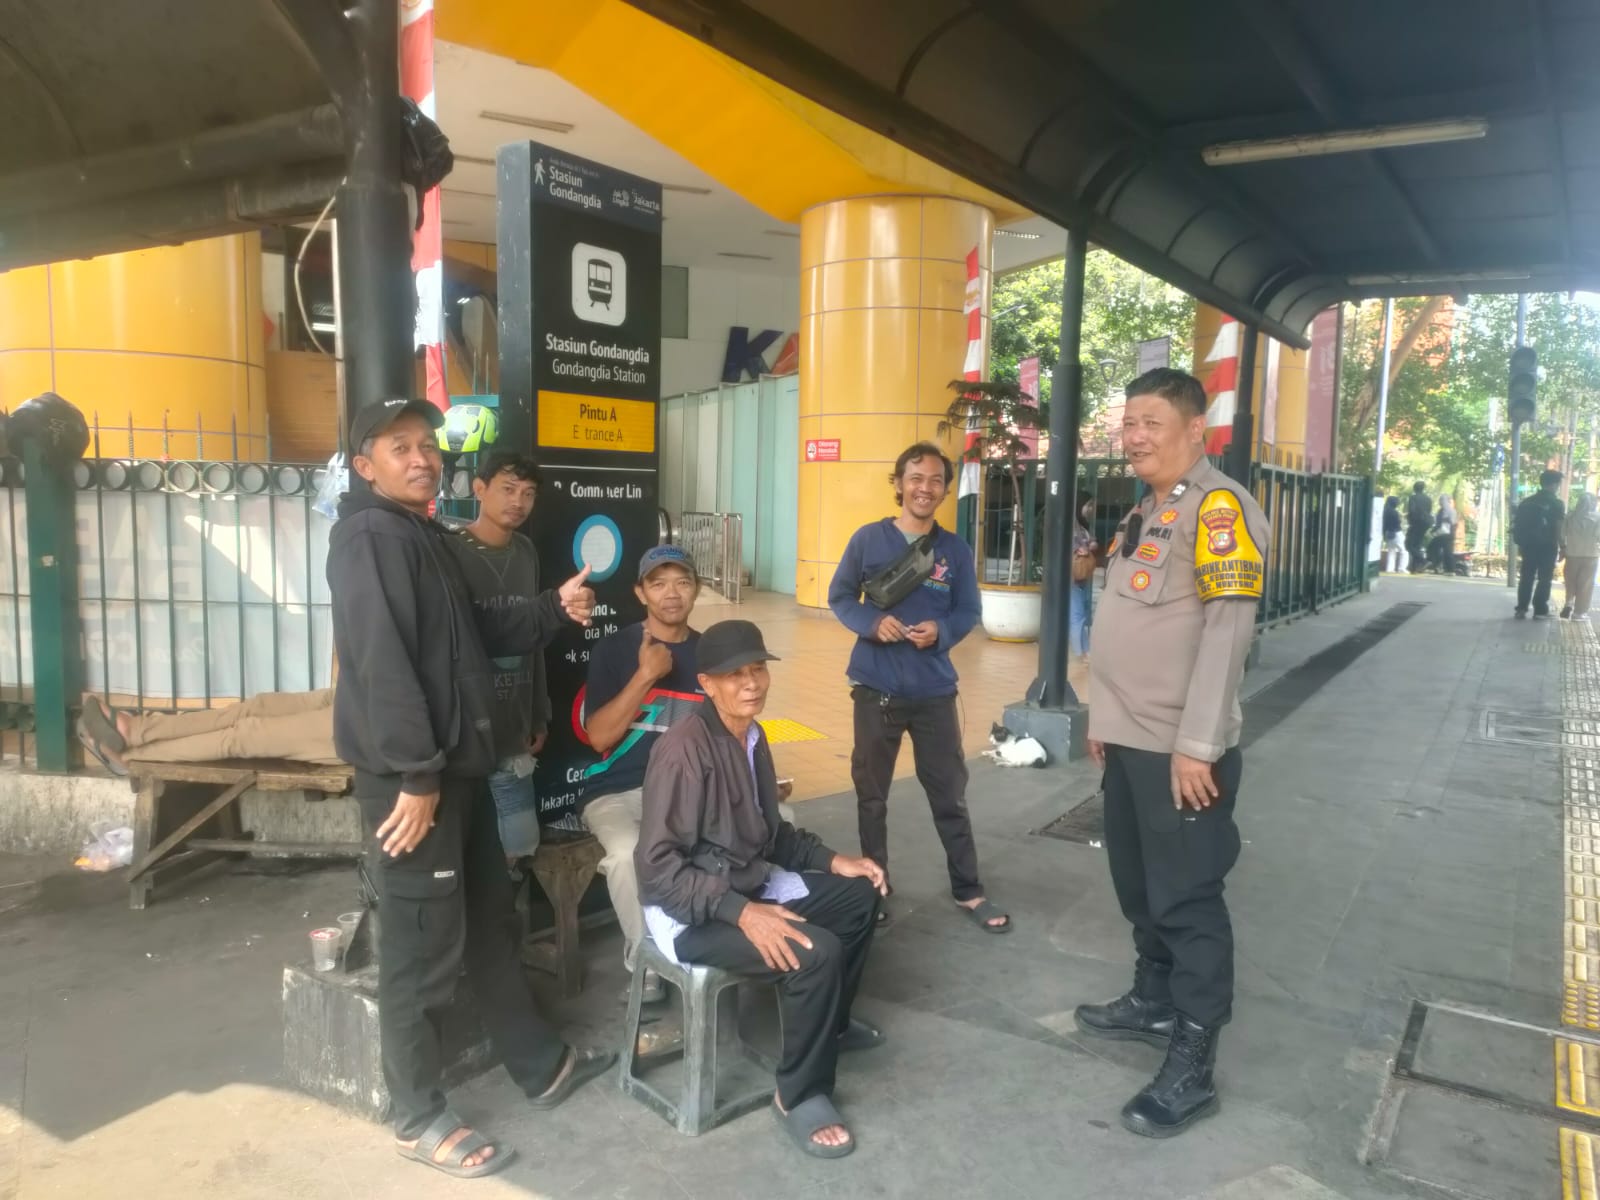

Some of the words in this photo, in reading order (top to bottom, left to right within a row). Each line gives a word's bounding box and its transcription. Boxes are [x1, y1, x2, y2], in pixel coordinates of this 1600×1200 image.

[549, 165, 583, 188] Stasiun
[549, 181, 602, 209] Gondangdia
[545, 332, 587, 355] Stasiun
[589, 339, 650, 365] Gondangdia
[552, 358, 611, 383] Gondangdia
[613, 365, 646, 384] Station
[579, 403, 607, 421] Pintu
[609, 406, 617, 422] A
[573, 424, 614, 442] Etrance
[616, 428, 624, 442] A
[540, 792, 575, 813] Jakarta
